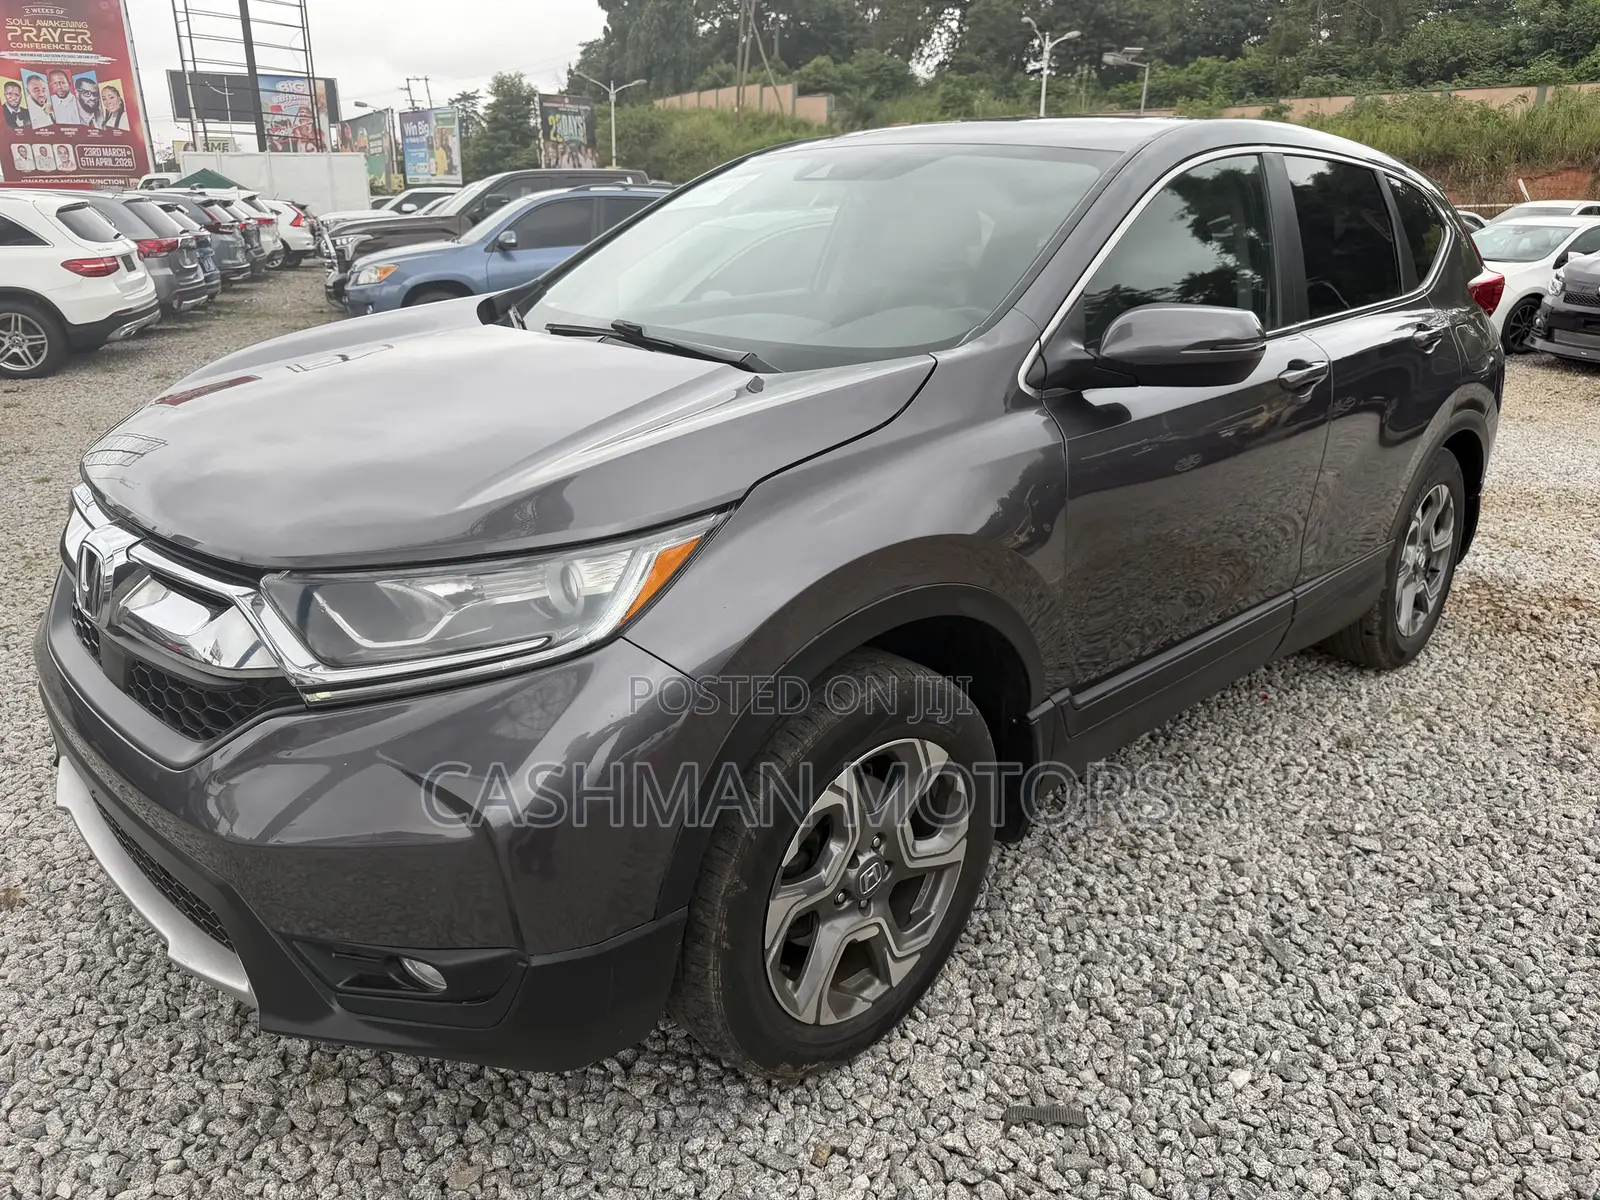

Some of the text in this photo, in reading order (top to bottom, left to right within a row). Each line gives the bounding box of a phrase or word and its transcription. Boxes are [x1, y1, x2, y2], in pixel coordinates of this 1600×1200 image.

[5, 18, 88, 28] SOUL AWAKENING
[5, 26, 93, 44] PRAYER
[10, 42, 71, 50] CONFERENCE
[404, 119, 430, 137] Win Big
[83, 147, 127, 157] 23RD MARCH
[80, 157, 95, 167] 5TH
